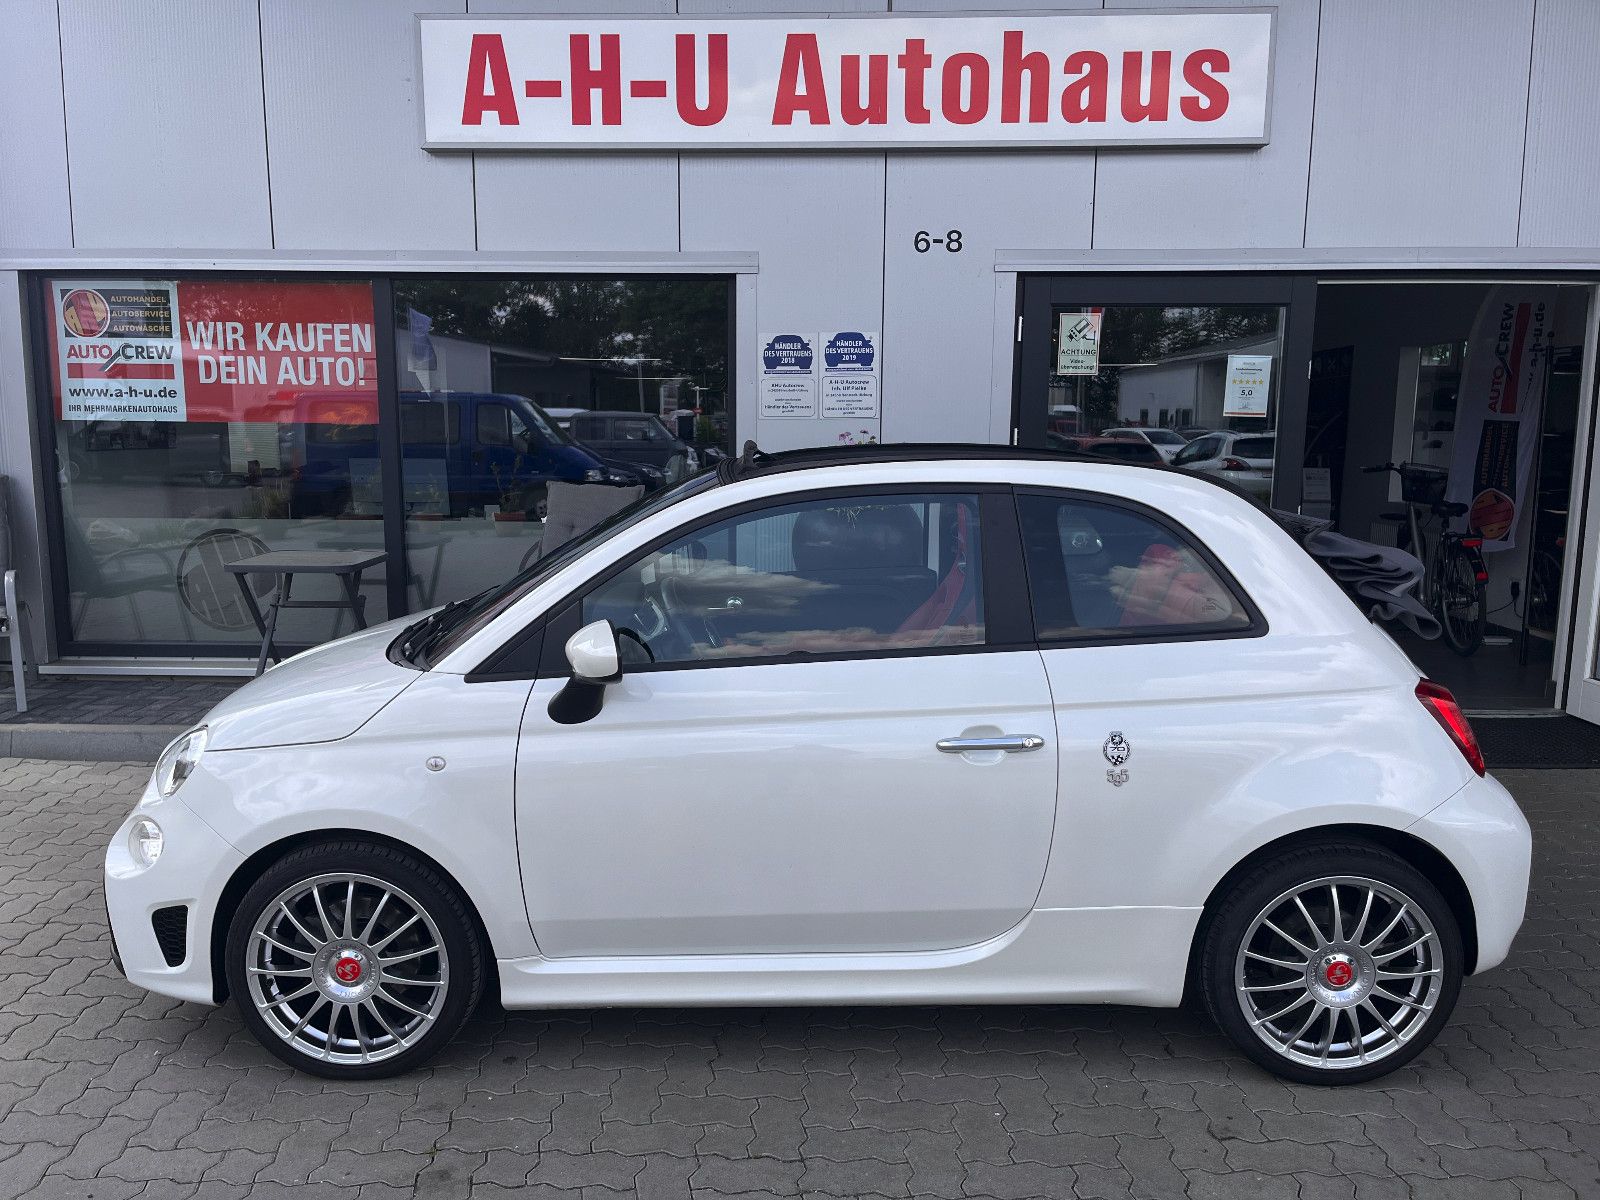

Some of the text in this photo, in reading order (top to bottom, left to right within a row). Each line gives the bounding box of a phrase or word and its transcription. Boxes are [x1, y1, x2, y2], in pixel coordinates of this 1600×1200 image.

[461, 30, 1231, 127] A-H-U Autohaus
[914, 229, 963, 253] 6-8
[110, 295, 167, 303] AUTOHANDEL
[111, 310, 170, 318] AUTOSERVICE
[186, 321, 372, 353] WIR KAUFEN
[774, 342, 801, 350] HÄNDLER
[836, 339, 863, 347] HÄNDLER
[67, 343, 174, 361] AUTO CREW
[764, 350, 776, 358] DES
[198, 354, 365, 386] DEIN AUTO!
[68, 386, 178, 399] www.a-h-u.de
[68, 404, 178, 414] IHR MEHRMARKENAUTOHAUS
